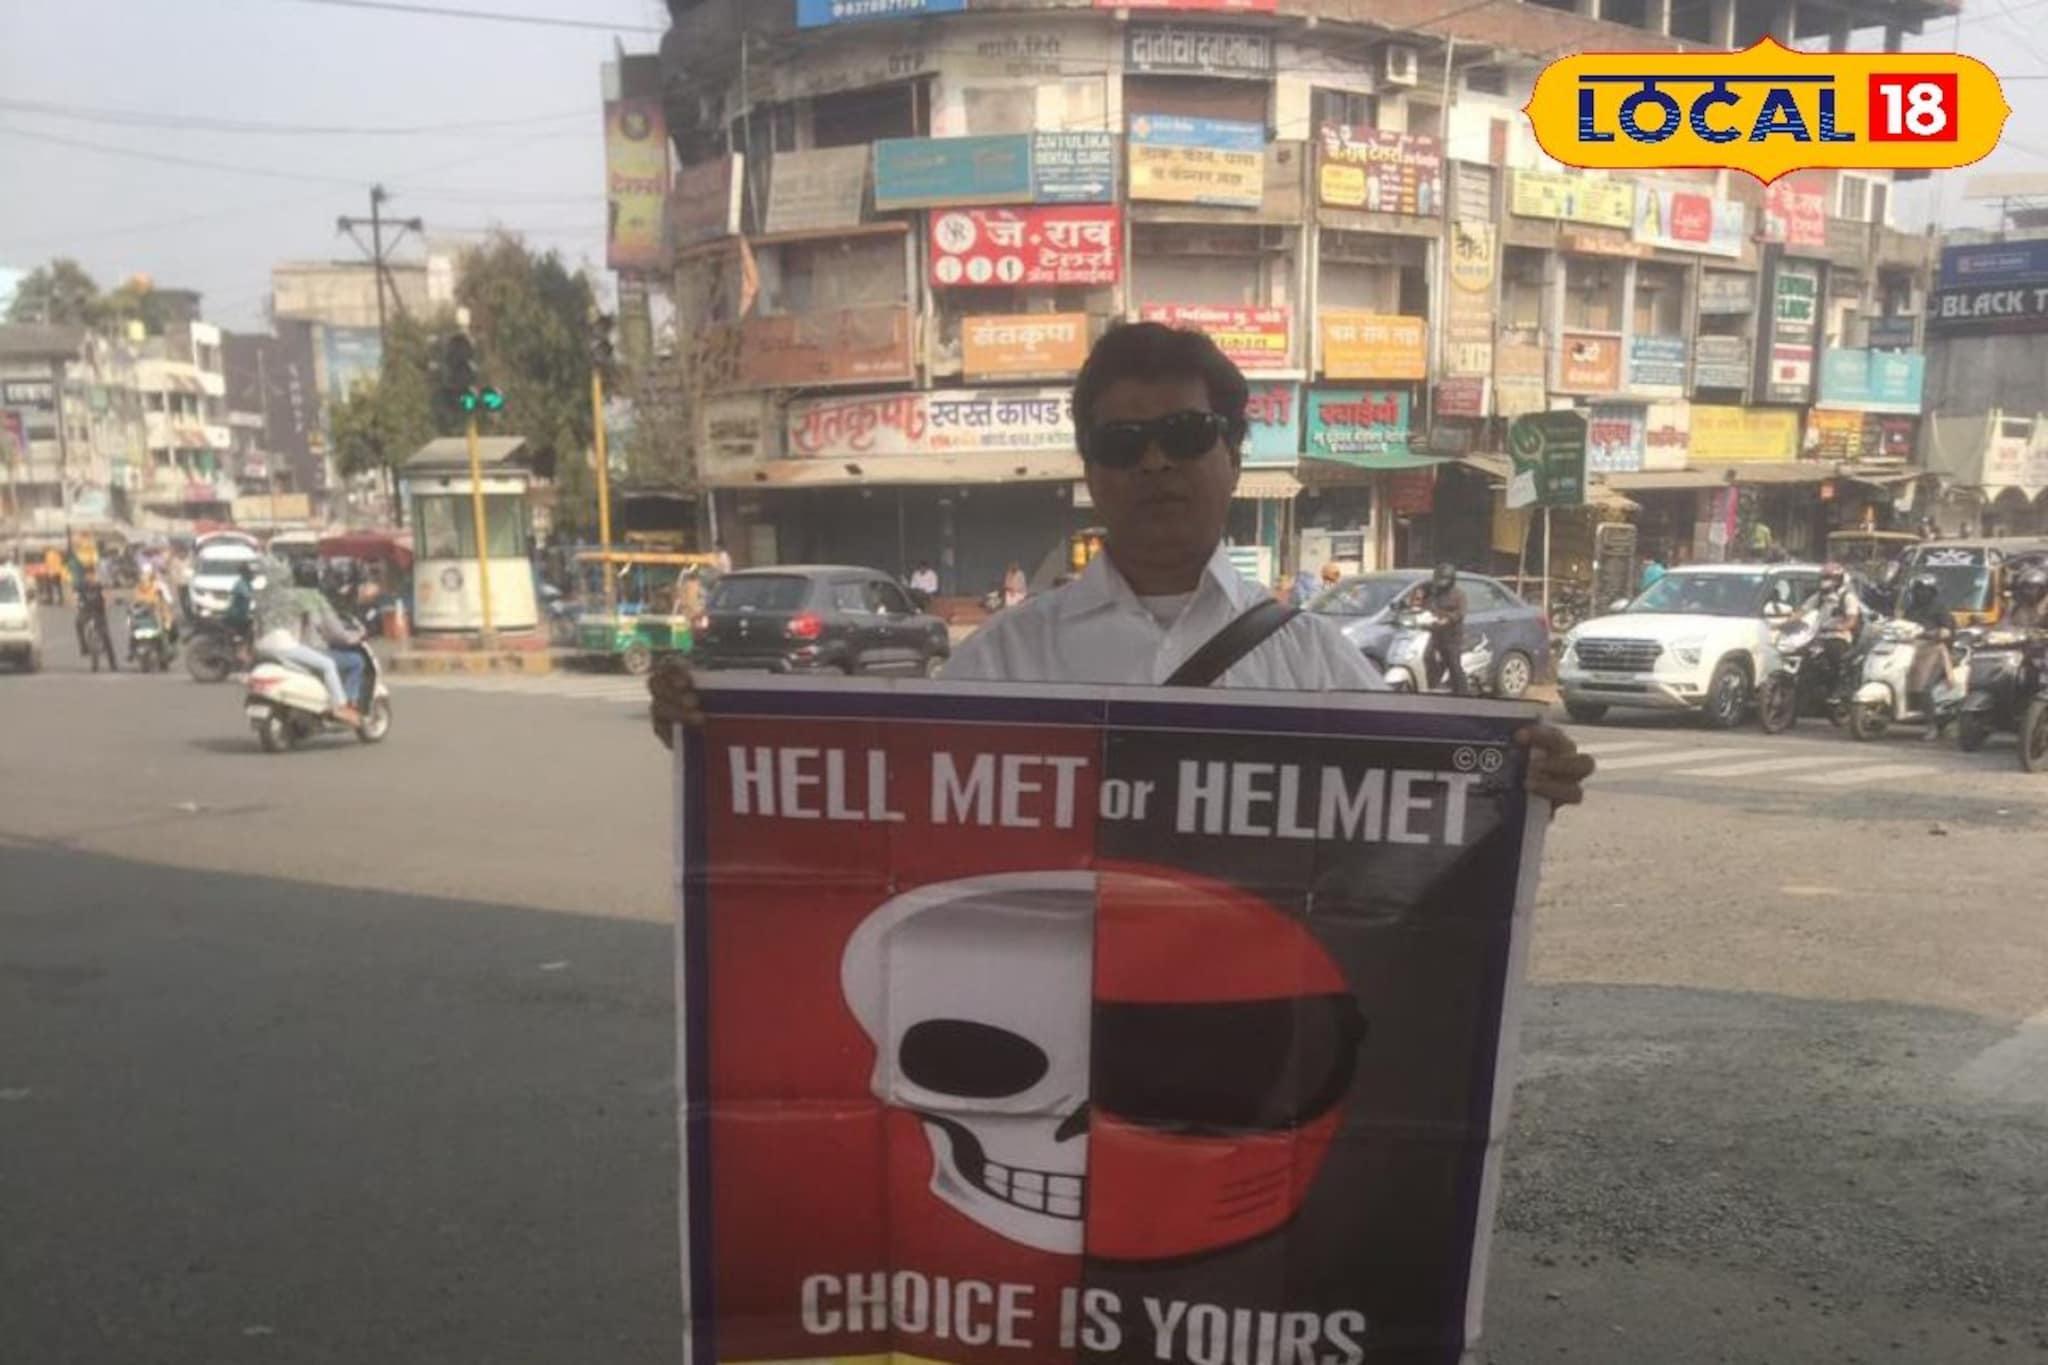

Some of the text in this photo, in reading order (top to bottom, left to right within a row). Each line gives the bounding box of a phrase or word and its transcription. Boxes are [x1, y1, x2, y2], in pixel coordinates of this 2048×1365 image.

[1942, 289, 2025, 317] BLACK
[996, 398, 1060, 426] कापड
[728, 745, 1482, 847] HELL MET or HELMET
[802, 1272, 1367, 1365] CHOICE IS YOURS
